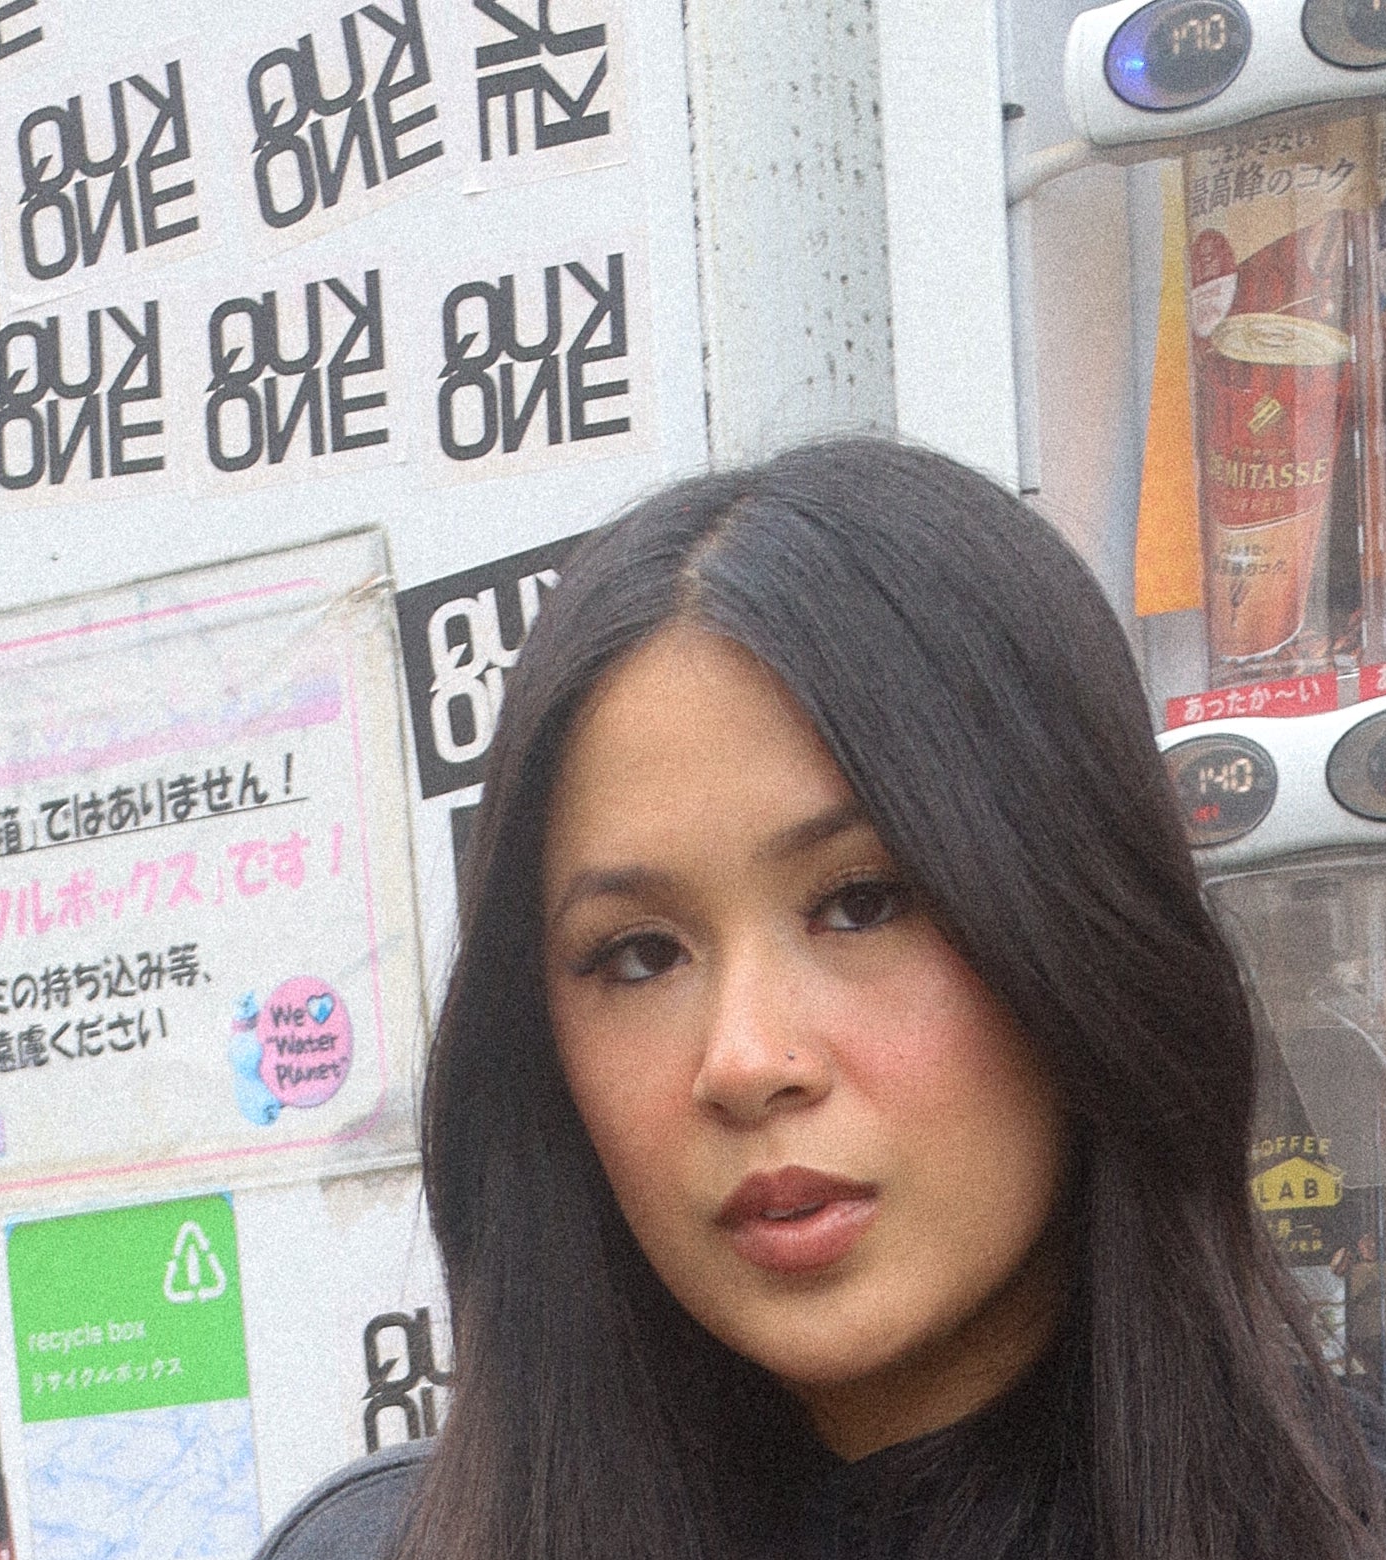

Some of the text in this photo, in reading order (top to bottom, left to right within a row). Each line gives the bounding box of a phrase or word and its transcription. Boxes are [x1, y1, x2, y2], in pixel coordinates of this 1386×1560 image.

[1169, 14, 1227, 55] 170
[1189, 157, 1356, 219] 最高峰のコク
[1198, 760, 1254, 794] 140
[270, 1004, 305, 1028] We
[1257, 1175, 1321, 1201] LAB
[27, 1317, 147, 1356] recycle box
[31, 1357, 184, 1395] リサイクルボックス
